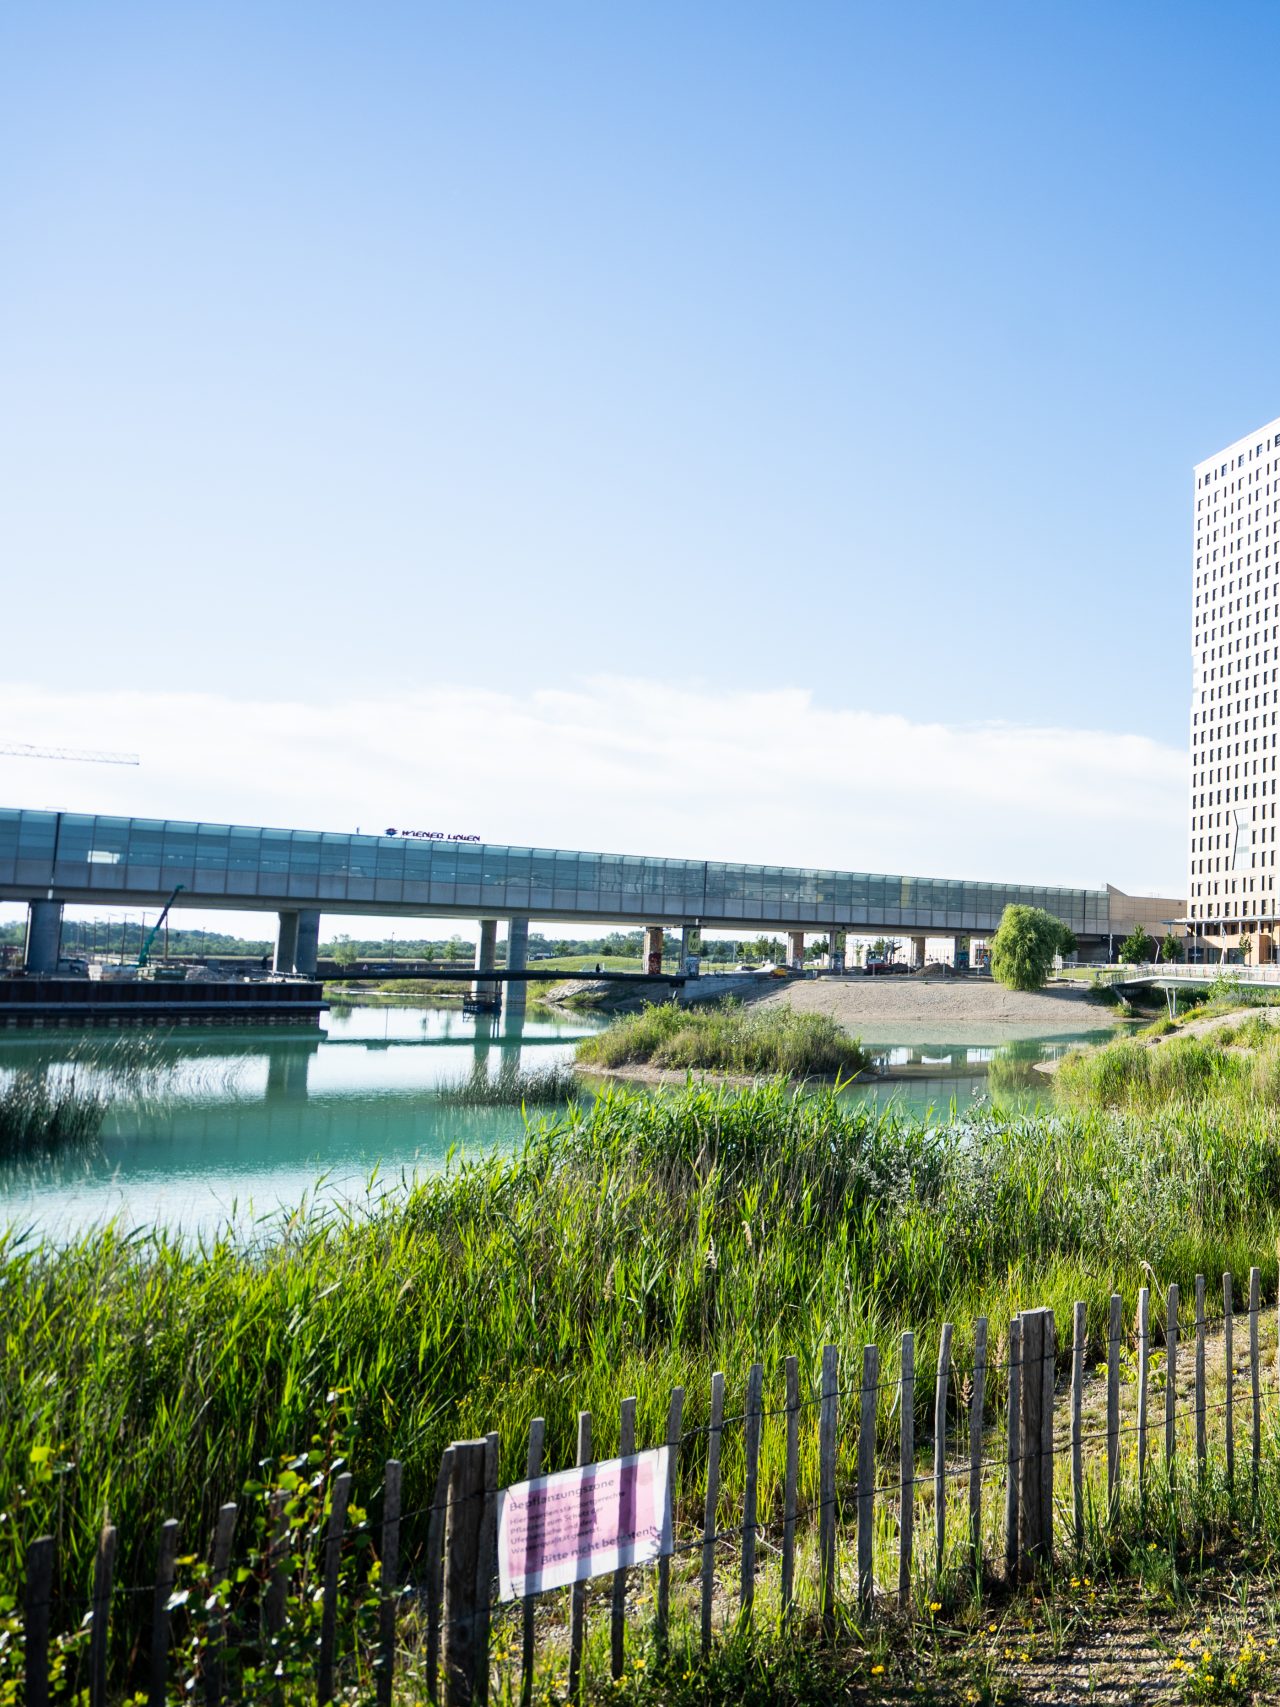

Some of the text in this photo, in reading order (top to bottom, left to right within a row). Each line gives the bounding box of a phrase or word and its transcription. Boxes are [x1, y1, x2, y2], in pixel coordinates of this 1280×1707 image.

[402, 830, 444, 839] WIENER
[510, 1479, 614, 1512] Bepflanzungszone
[540, 1549, 568, 1565] Bitte
[571, 1541, 600, 1556] nicht
